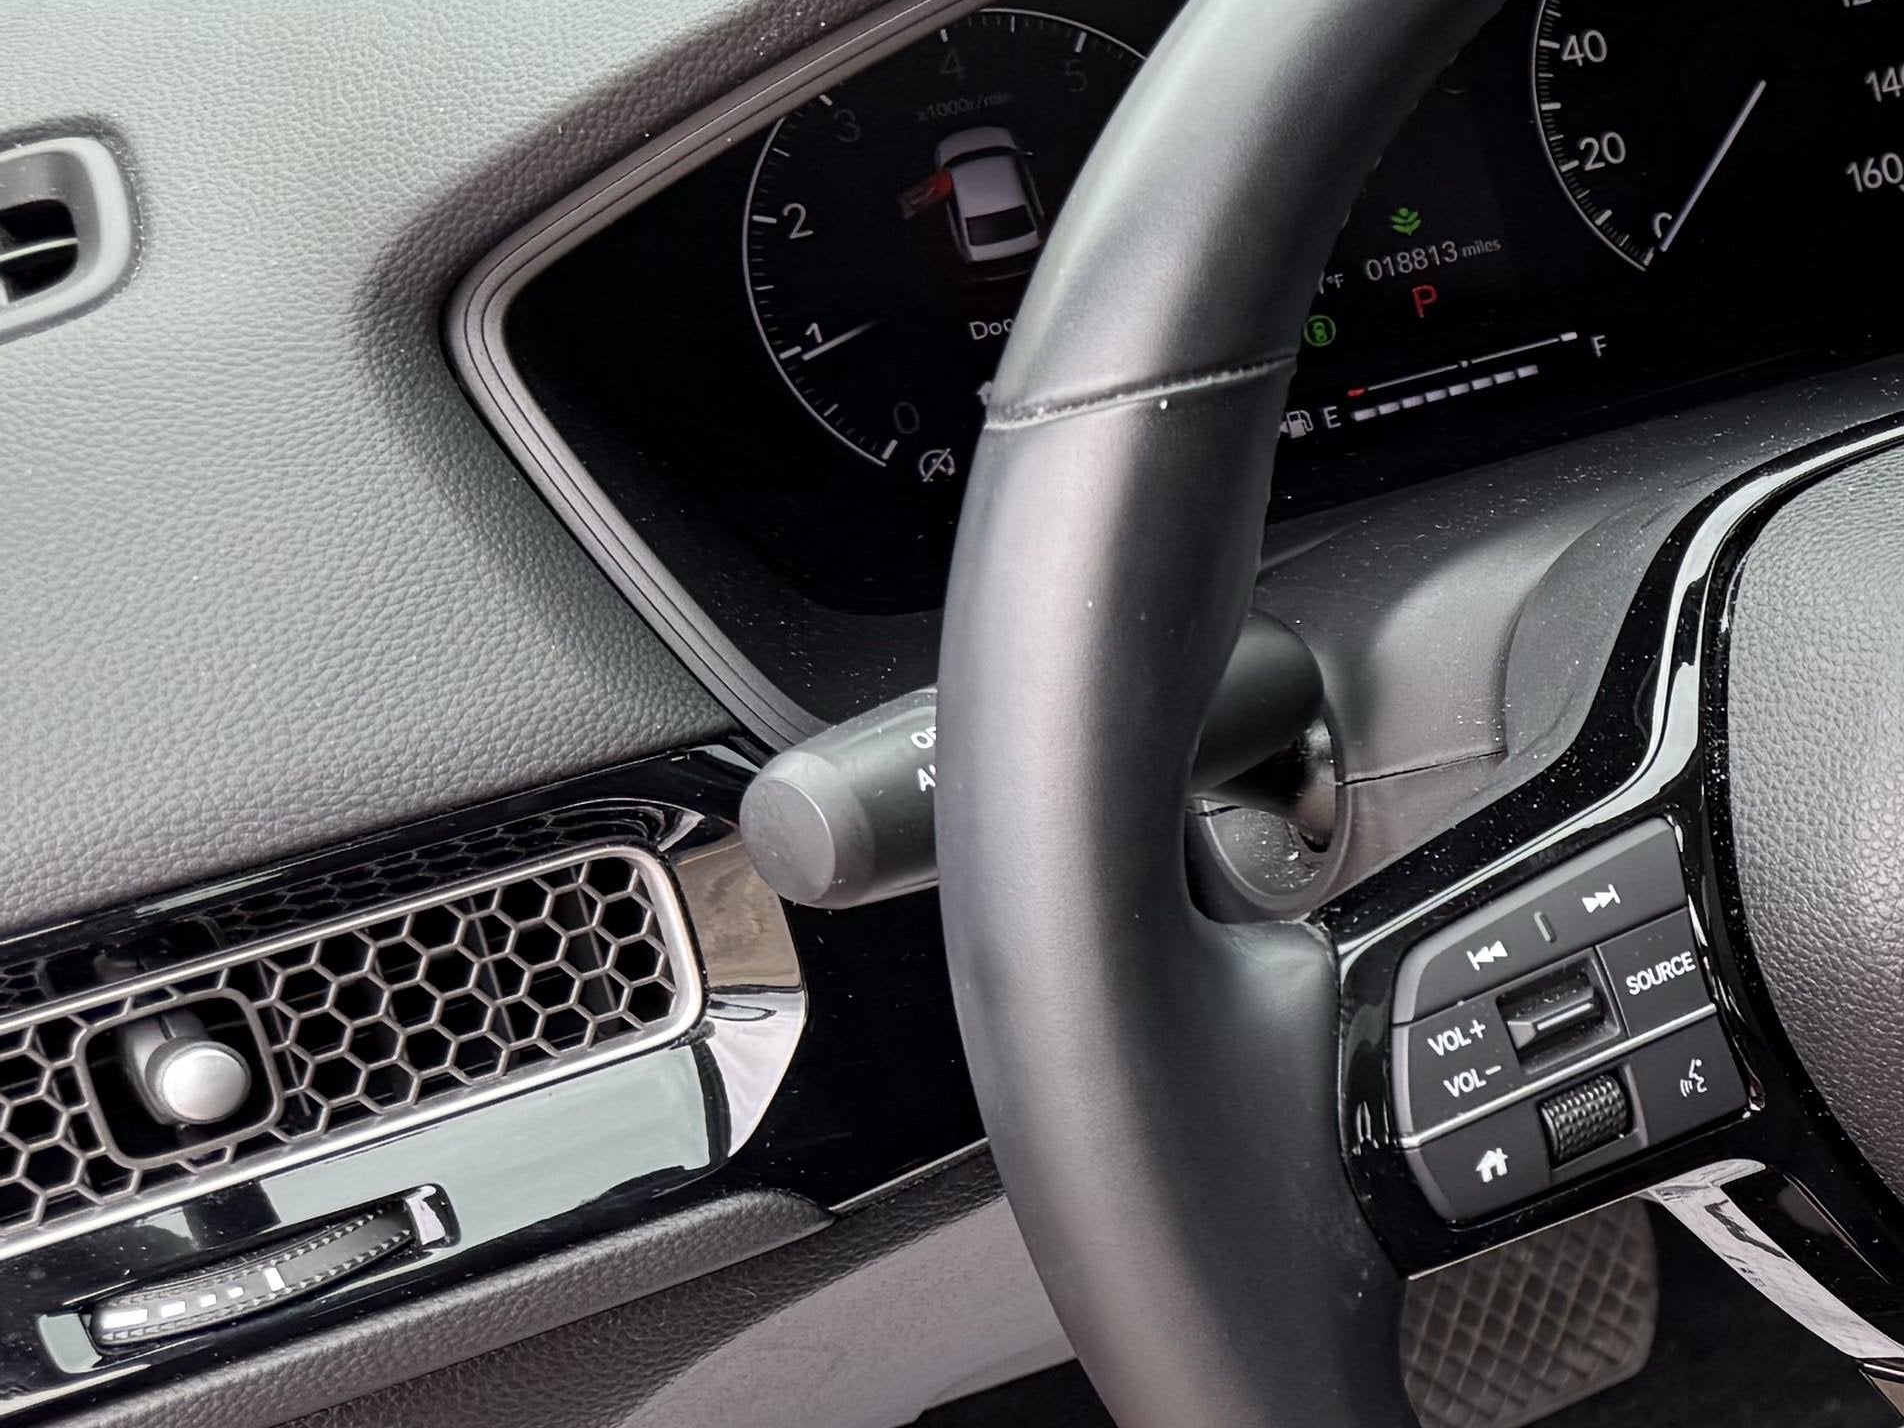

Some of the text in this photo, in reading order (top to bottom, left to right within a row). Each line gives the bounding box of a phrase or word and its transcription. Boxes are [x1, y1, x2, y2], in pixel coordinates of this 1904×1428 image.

[941, 47, 965, 80] 4
[1560, 29, 1608, 66] 40
[1063, 58, 1088, 93] 5
[833, 108, 862, 143] 3
[1578, 131, 1627, 172] 20
[1845, 152, 1904, 193] 160
[782, 201, 815, 240] 2
[1364, 236, 1501, 283] 018813 miles
[1410, 283, 1439, 319] P
[1589, 334, 1609, 358] F
[892, 400, 920, 435] 0
[1320, 405, 1342, 430] E
[1625, 950, 1697, 996] SOURCE
